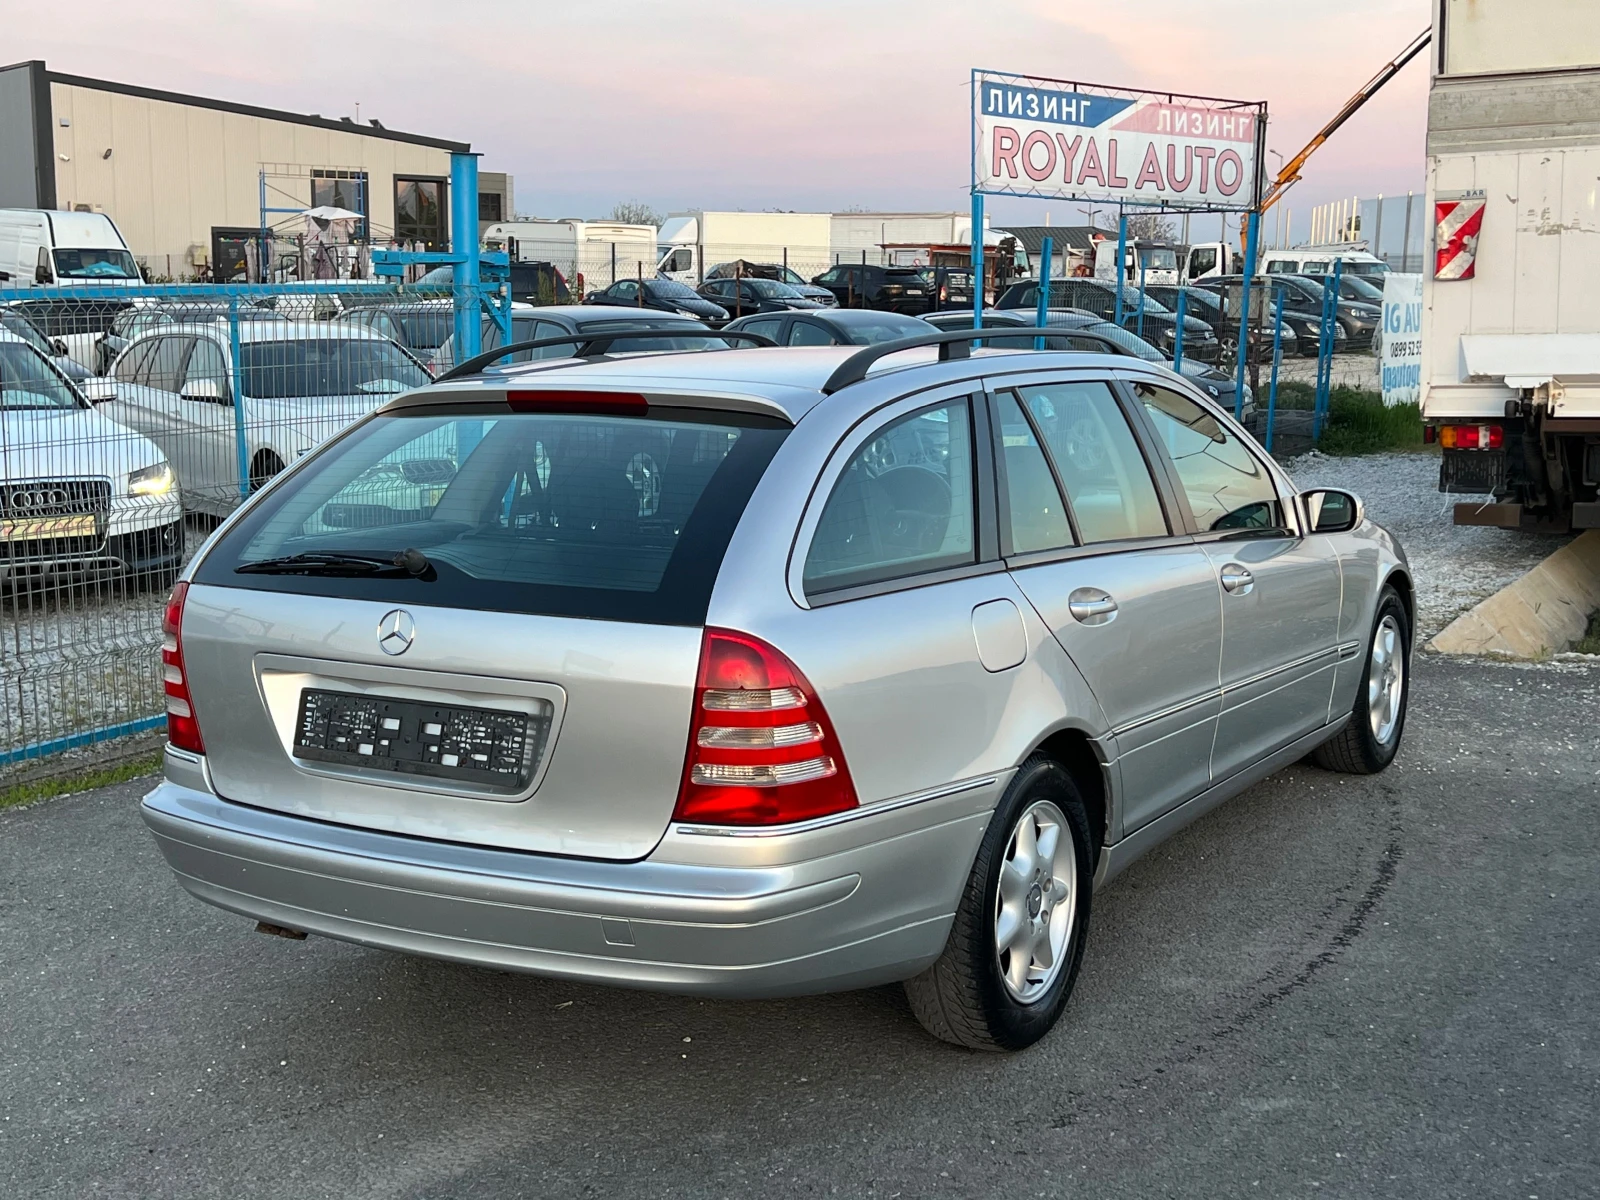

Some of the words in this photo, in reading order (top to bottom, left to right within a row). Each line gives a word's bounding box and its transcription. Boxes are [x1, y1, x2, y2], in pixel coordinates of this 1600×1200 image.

[987, 88, 1091, 123] ЛИЗИНГ
[1156, 109, 1249, 139] ЛИЗИНГ
[992, 126, 1128, 188] ROYAL
[1135, 141, 1244, 196] AUTO
[1384, 302, 1401, 334] IG
[1403, 302, 1422, 333] AU
